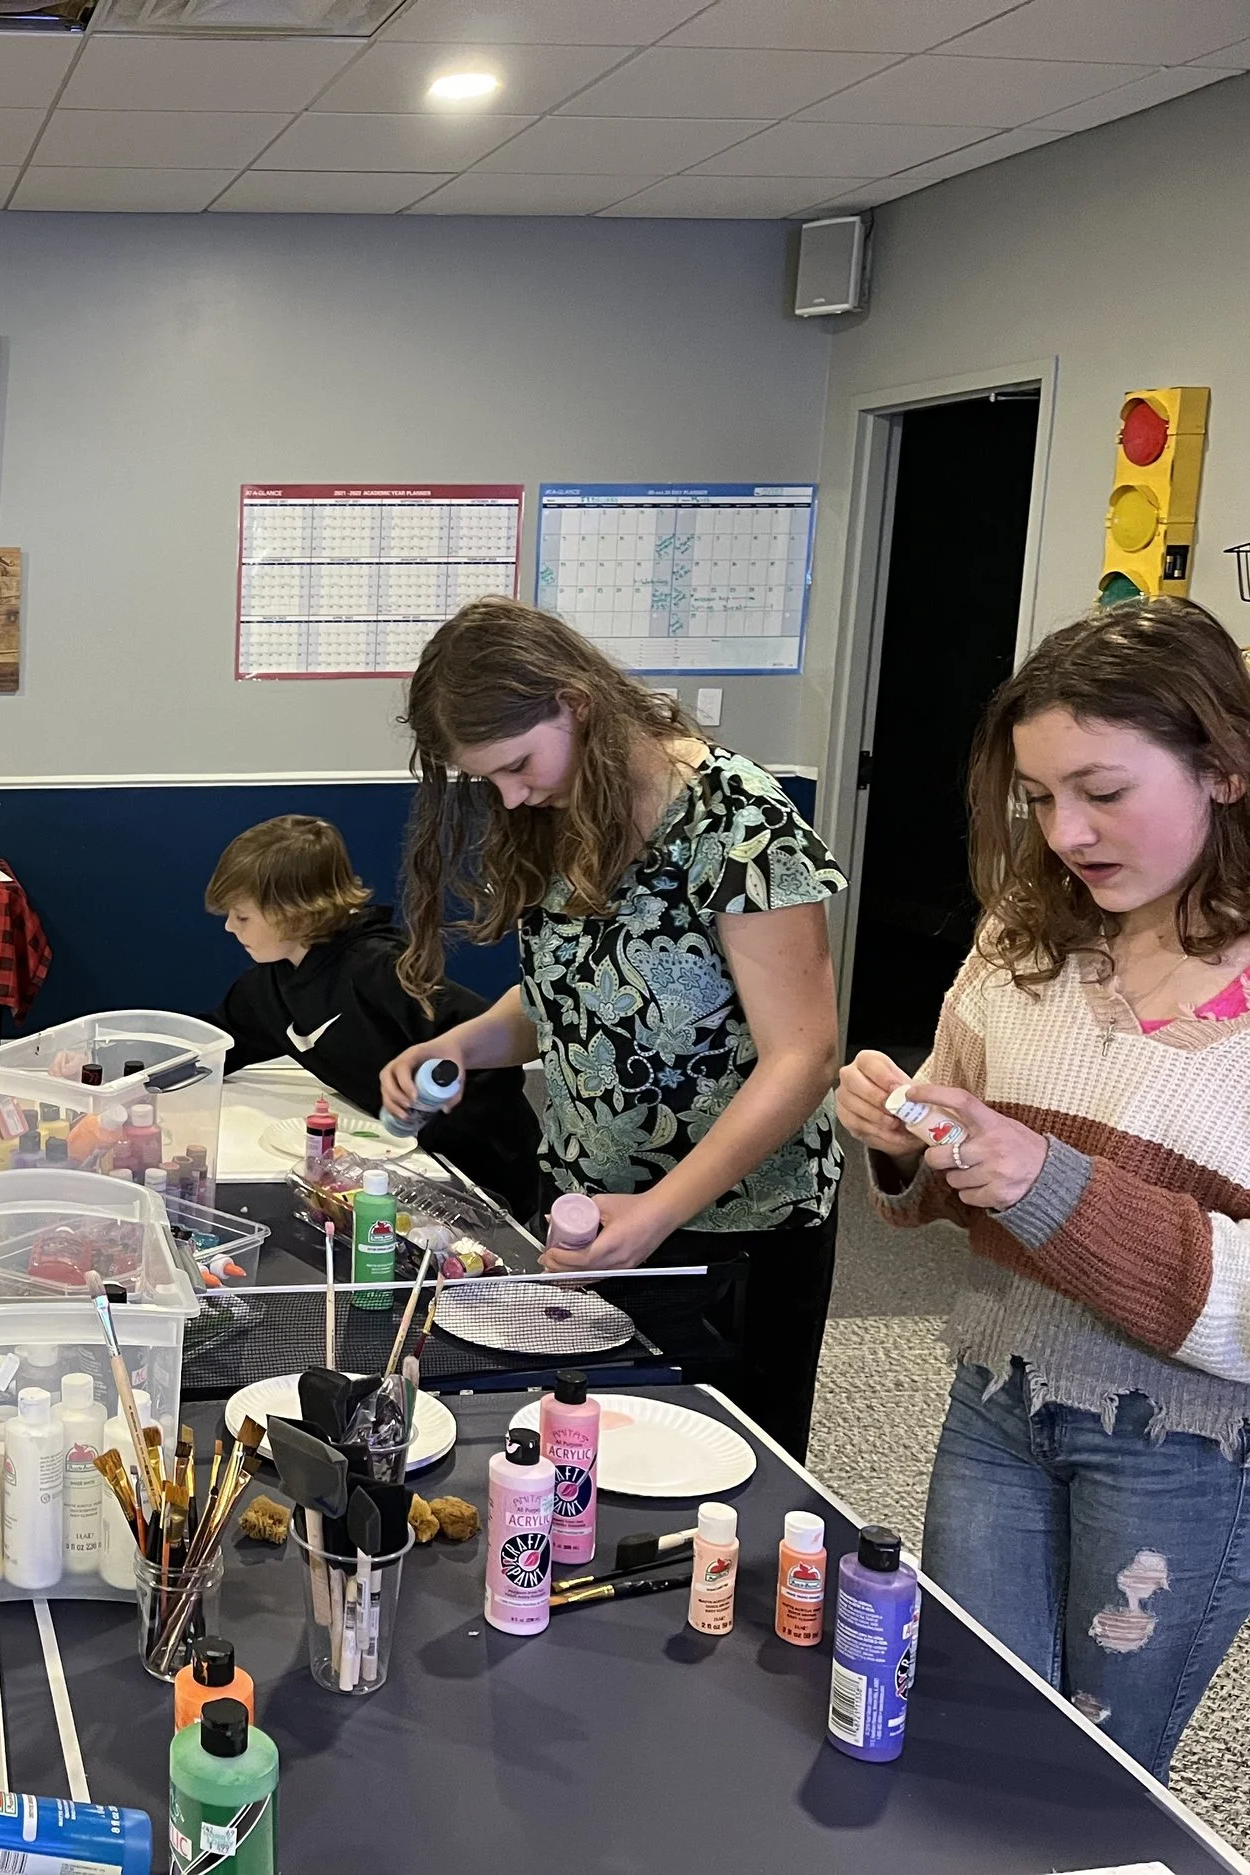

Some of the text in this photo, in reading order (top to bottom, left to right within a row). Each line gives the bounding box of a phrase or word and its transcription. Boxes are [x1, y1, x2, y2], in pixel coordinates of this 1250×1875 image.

[548, 1445, 591, 1460] ACRYLIC
[508, 1515, 549, 1527] ACRYLIC
[502, 1533, 542, 1562] CRAFT
[508, 1567, 544, 1588] PAINT
